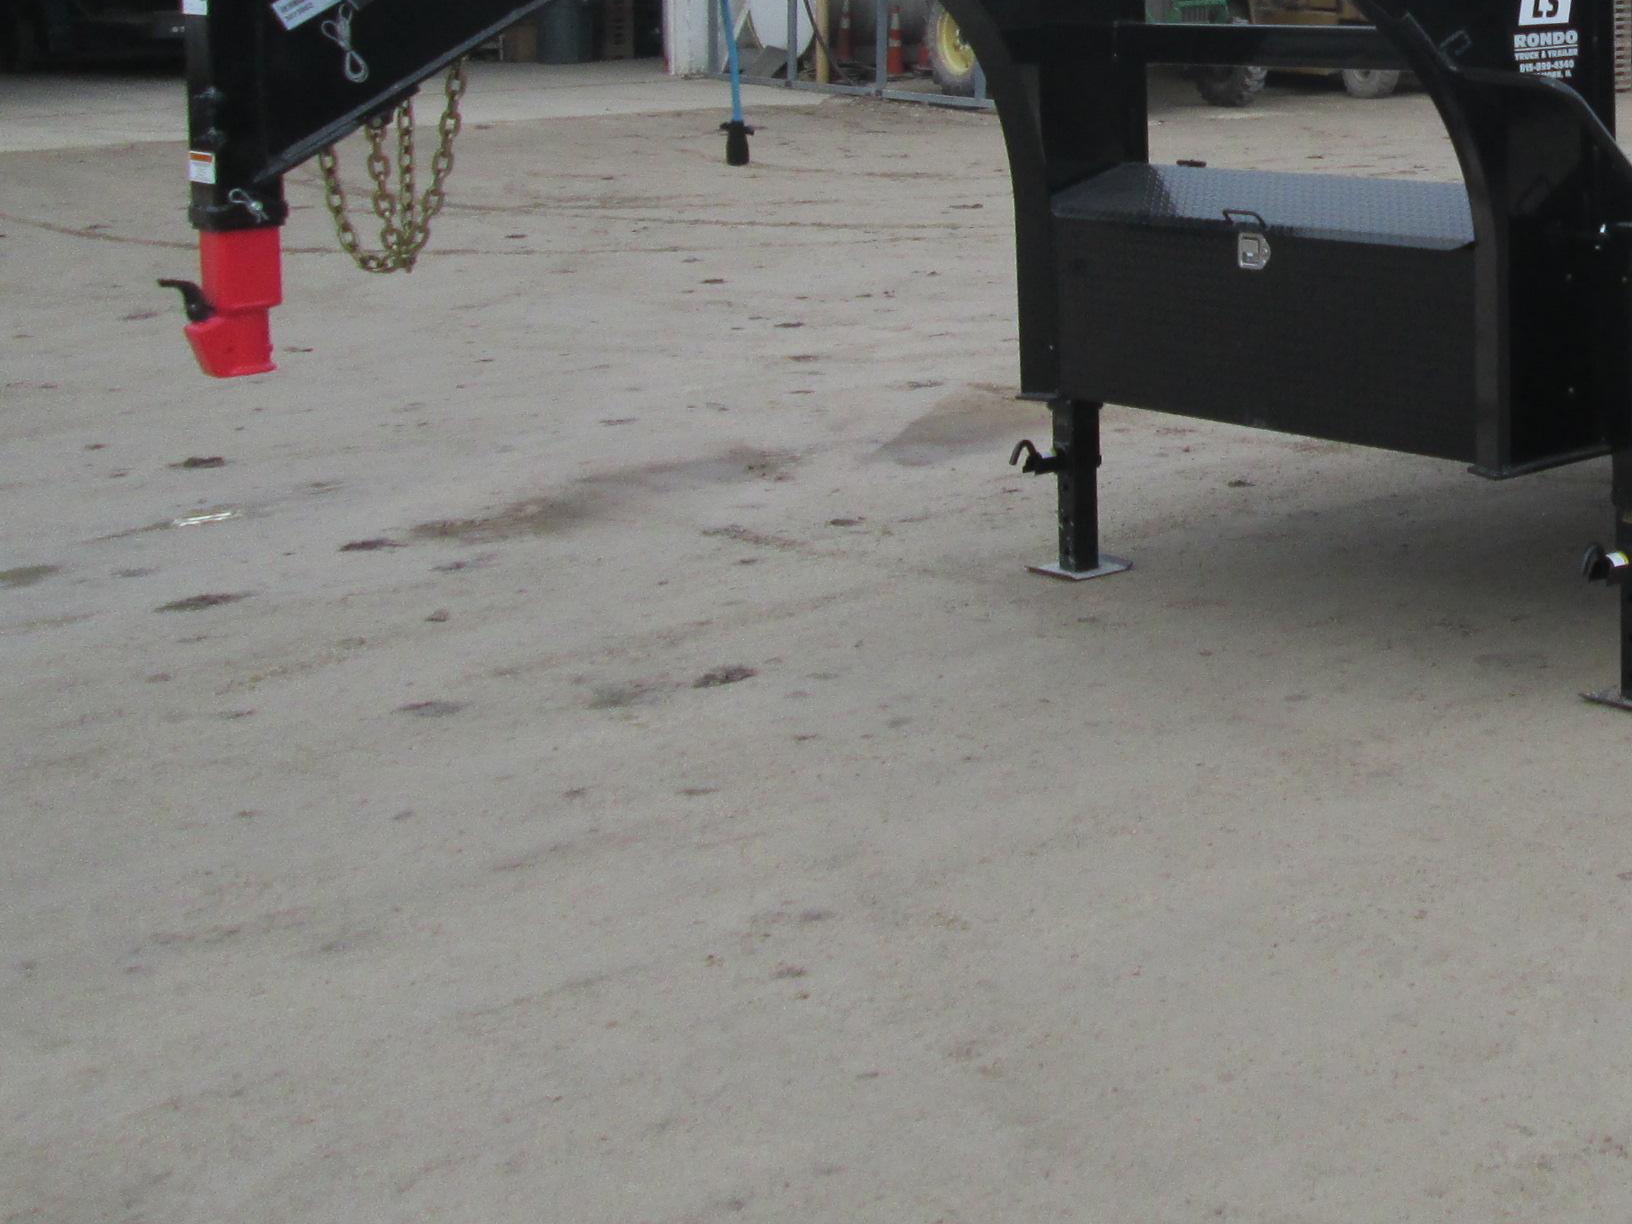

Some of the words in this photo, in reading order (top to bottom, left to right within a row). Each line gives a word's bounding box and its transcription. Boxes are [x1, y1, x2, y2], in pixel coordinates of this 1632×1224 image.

[1513, 30, 1578, 48] RONDO
[1514, 51, 1540, 61] TRUCK
[1547, 48, 1579, 58] TRAILER
